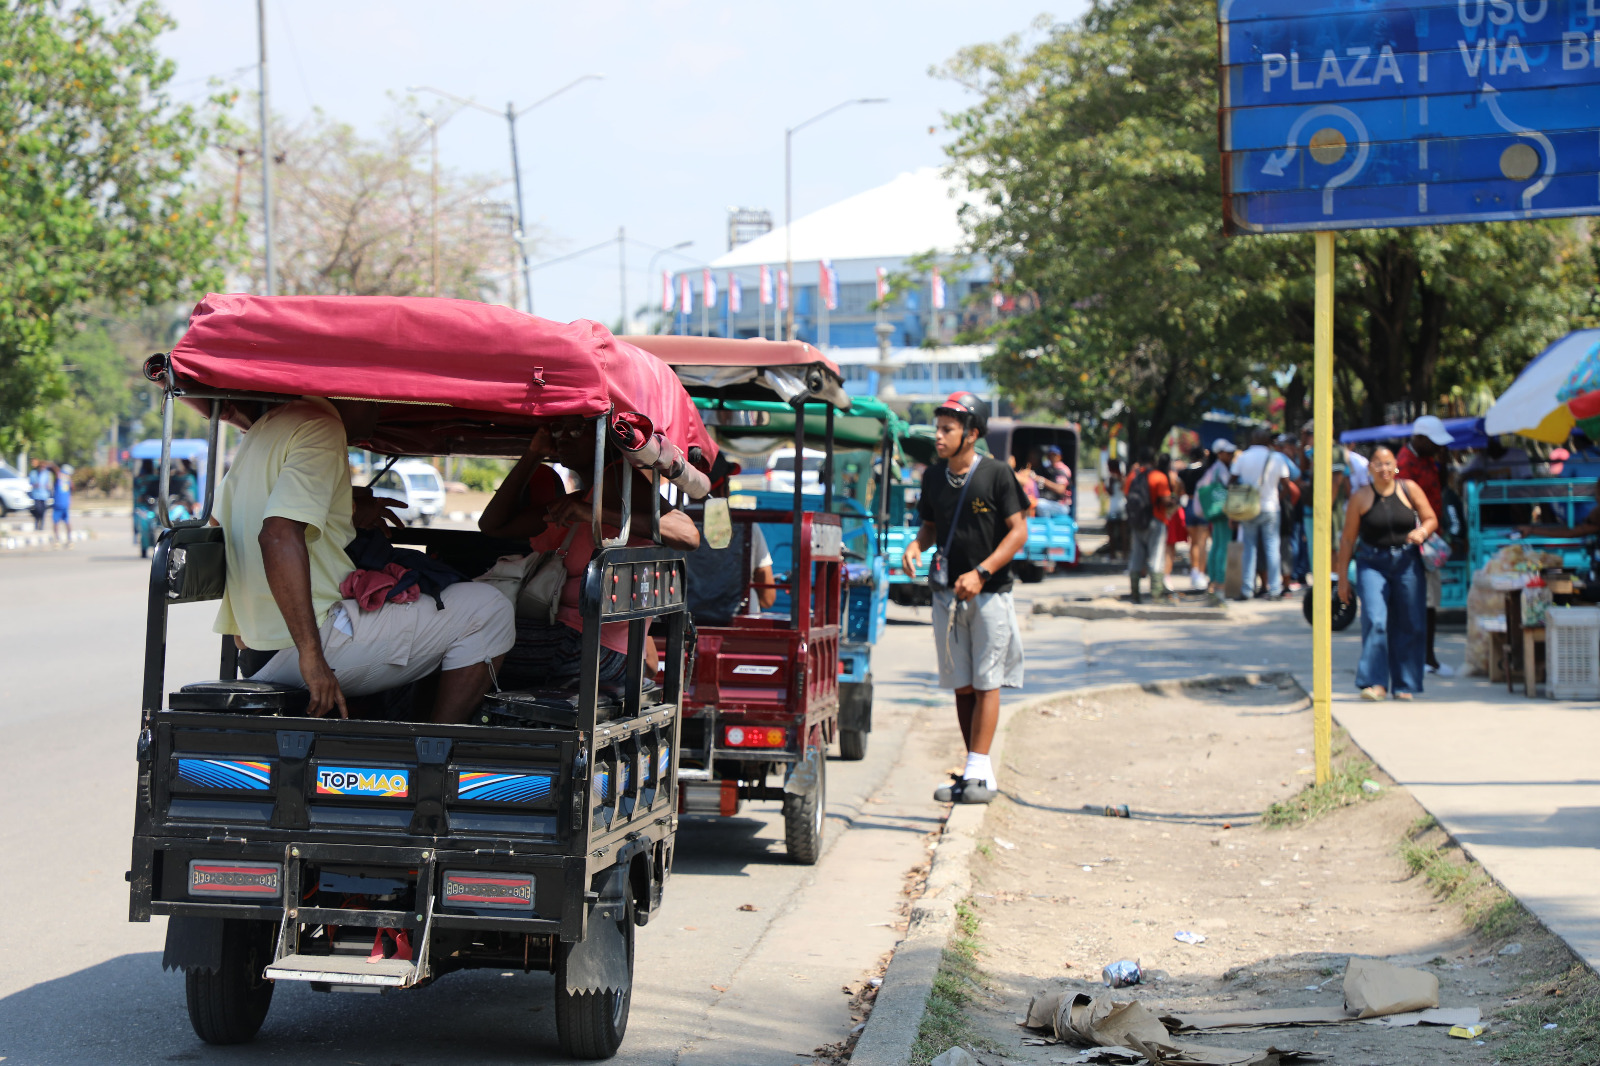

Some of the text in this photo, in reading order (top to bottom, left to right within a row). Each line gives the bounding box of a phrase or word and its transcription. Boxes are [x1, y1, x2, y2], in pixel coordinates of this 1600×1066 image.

[1458, 0, 1548, 27] USO
[1262, 45, 1404, 92] PLAZA
[1457, 35, 1530, 77] VIA
[1562, 30, 1600, 70] B
[320, 771, 406, 792] TOPMAQ
